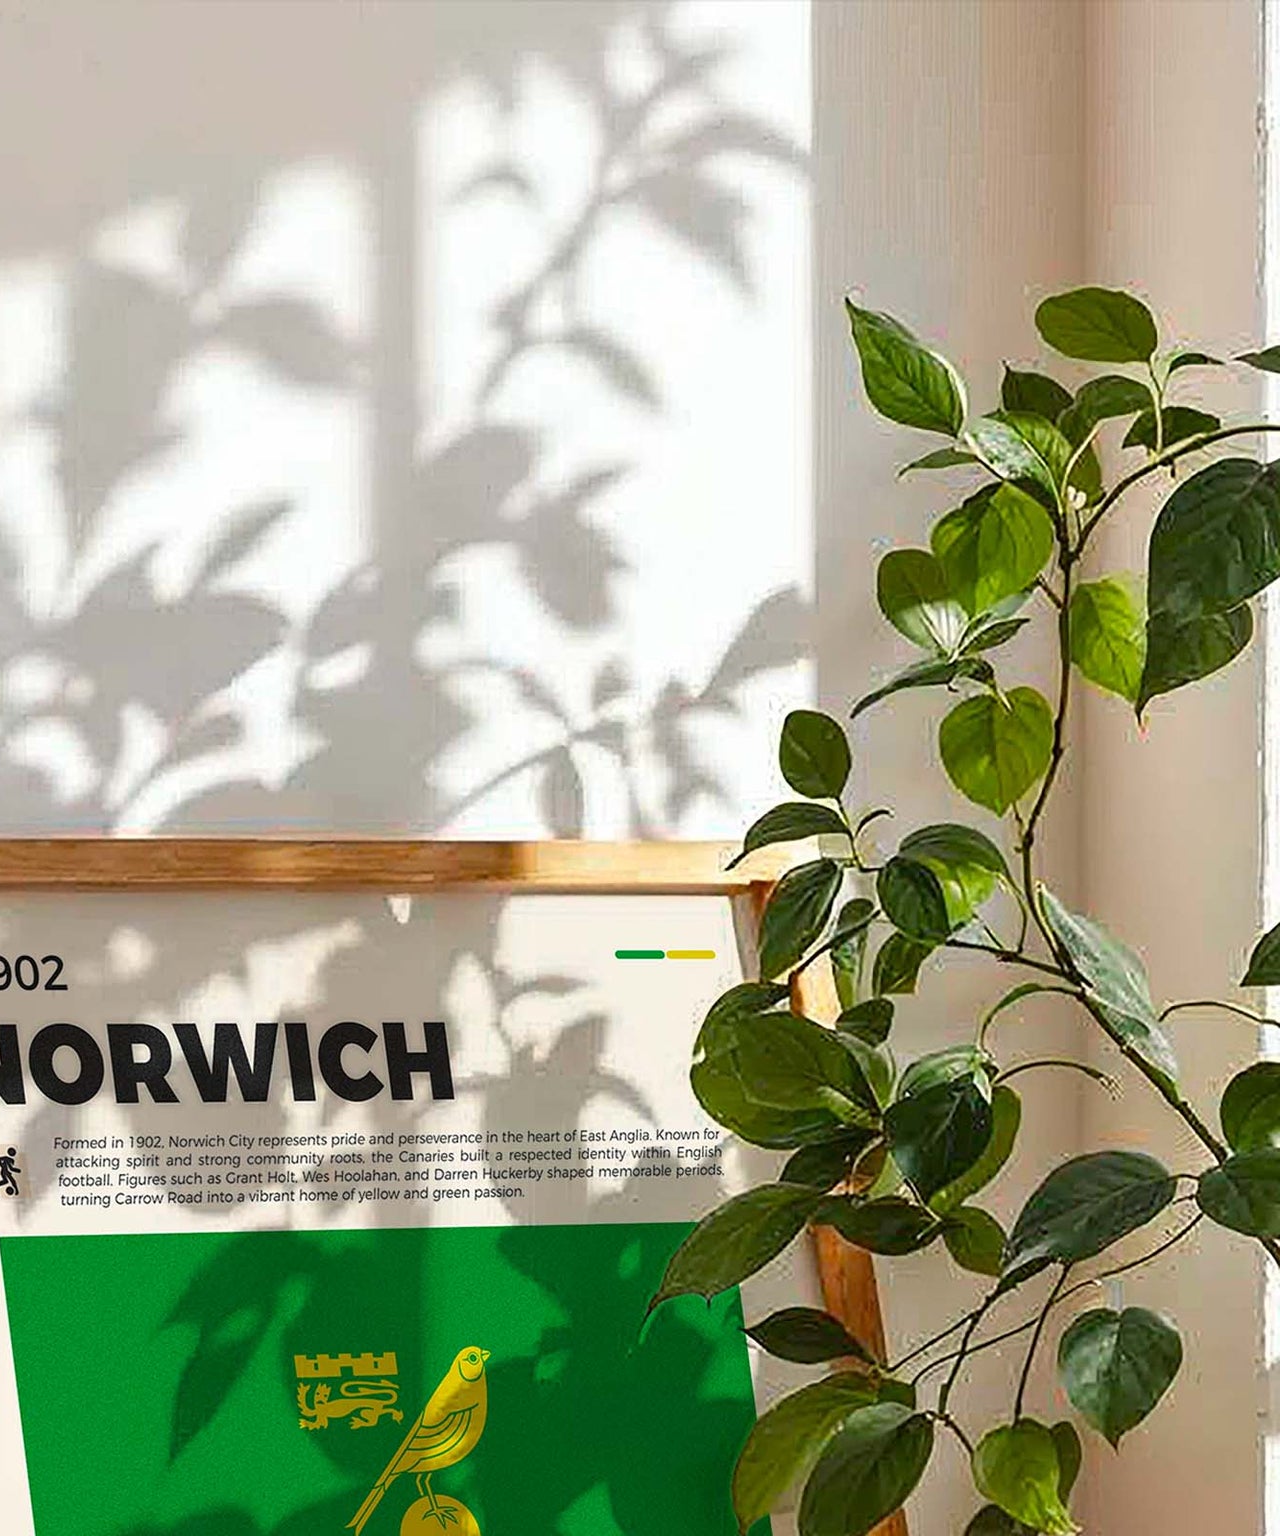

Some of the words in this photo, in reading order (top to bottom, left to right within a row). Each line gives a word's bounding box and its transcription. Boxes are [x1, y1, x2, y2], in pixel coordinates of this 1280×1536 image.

[53, 1136, 107, 1150] Formed
[111, 1136, 124, 1149] in
[168, 1134, 225, 1148] Norwich
[228, 1134, 255, 1150] City
[258, 1134, 328, 1150] represents
[331, 1132, 366, 1148] pride
[368, 1132, 394, 1145] and
[398, 1133, 483, 1148] perseverance
[486, 1130, 498, 1143] in
[502, 1130, 524, 1143] the
[527, 1130, 560, 1143] heart
[563, 1129, 578, 1142] of
[580, 1129, 606, 1142] East
[609, 1128, 652, 1144] Anglia.
[656, 1128, 700, 1141] Known
[703, 1127, 720, 1140] for
[60, 1192, 111, 1208] turning
[114, 1192, 164, 1205] Carrow
[167, 1190, 203, 1204] Road
[207, 1190, 234, 1203] into
[236, 1192, 245, 1203] a
[248, 1189, 295, 1202] vibrant
[299, 1189, 338, 1201] home
[341, 1187, 356, 1201] of
[357, 1187, 400, 1204] yellow
[403, 1186, 429, 1200] and
[432, 1188, 470, 1202] green
[474, 1184, 525, 1201] passion.
